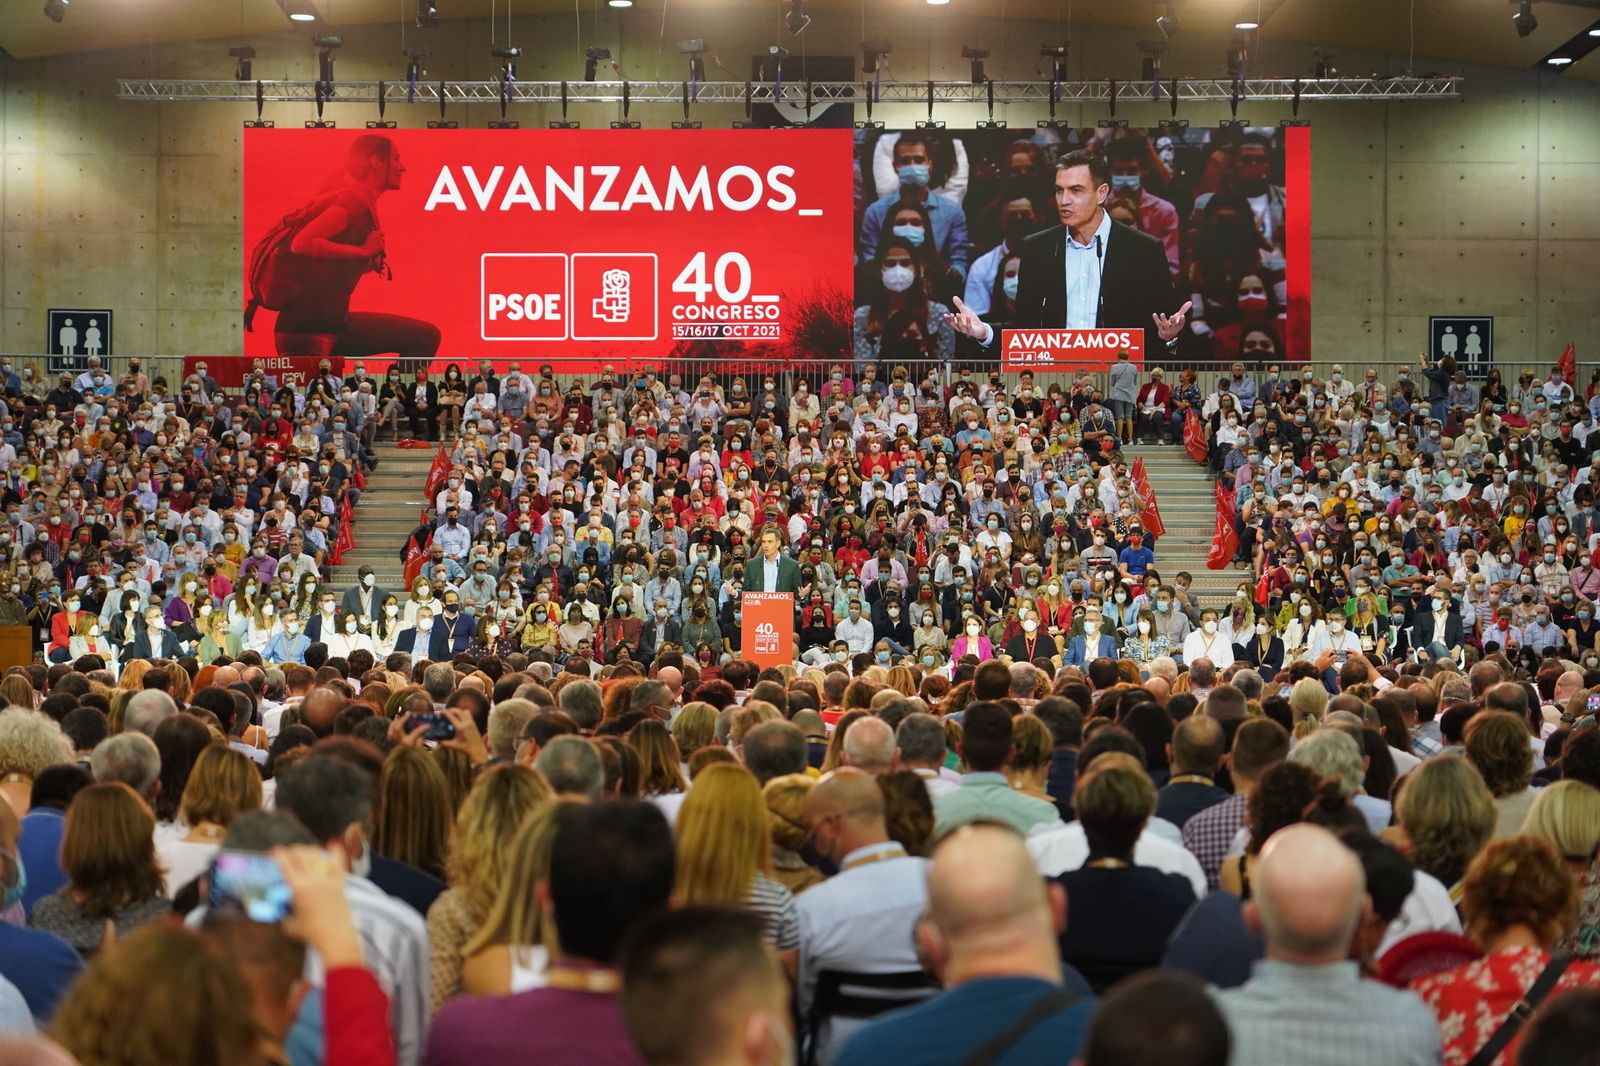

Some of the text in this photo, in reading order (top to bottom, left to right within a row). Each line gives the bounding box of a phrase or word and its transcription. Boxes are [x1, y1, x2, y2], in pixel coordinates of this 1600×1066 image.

[424, 165, 823, 216] AVANZAMOS_
[489, 293, 561, 321] PSOE
[672, 304, 780, 320] CONGRESO
[672, 325, 780, 337] 15/16/17 OCT 2021
